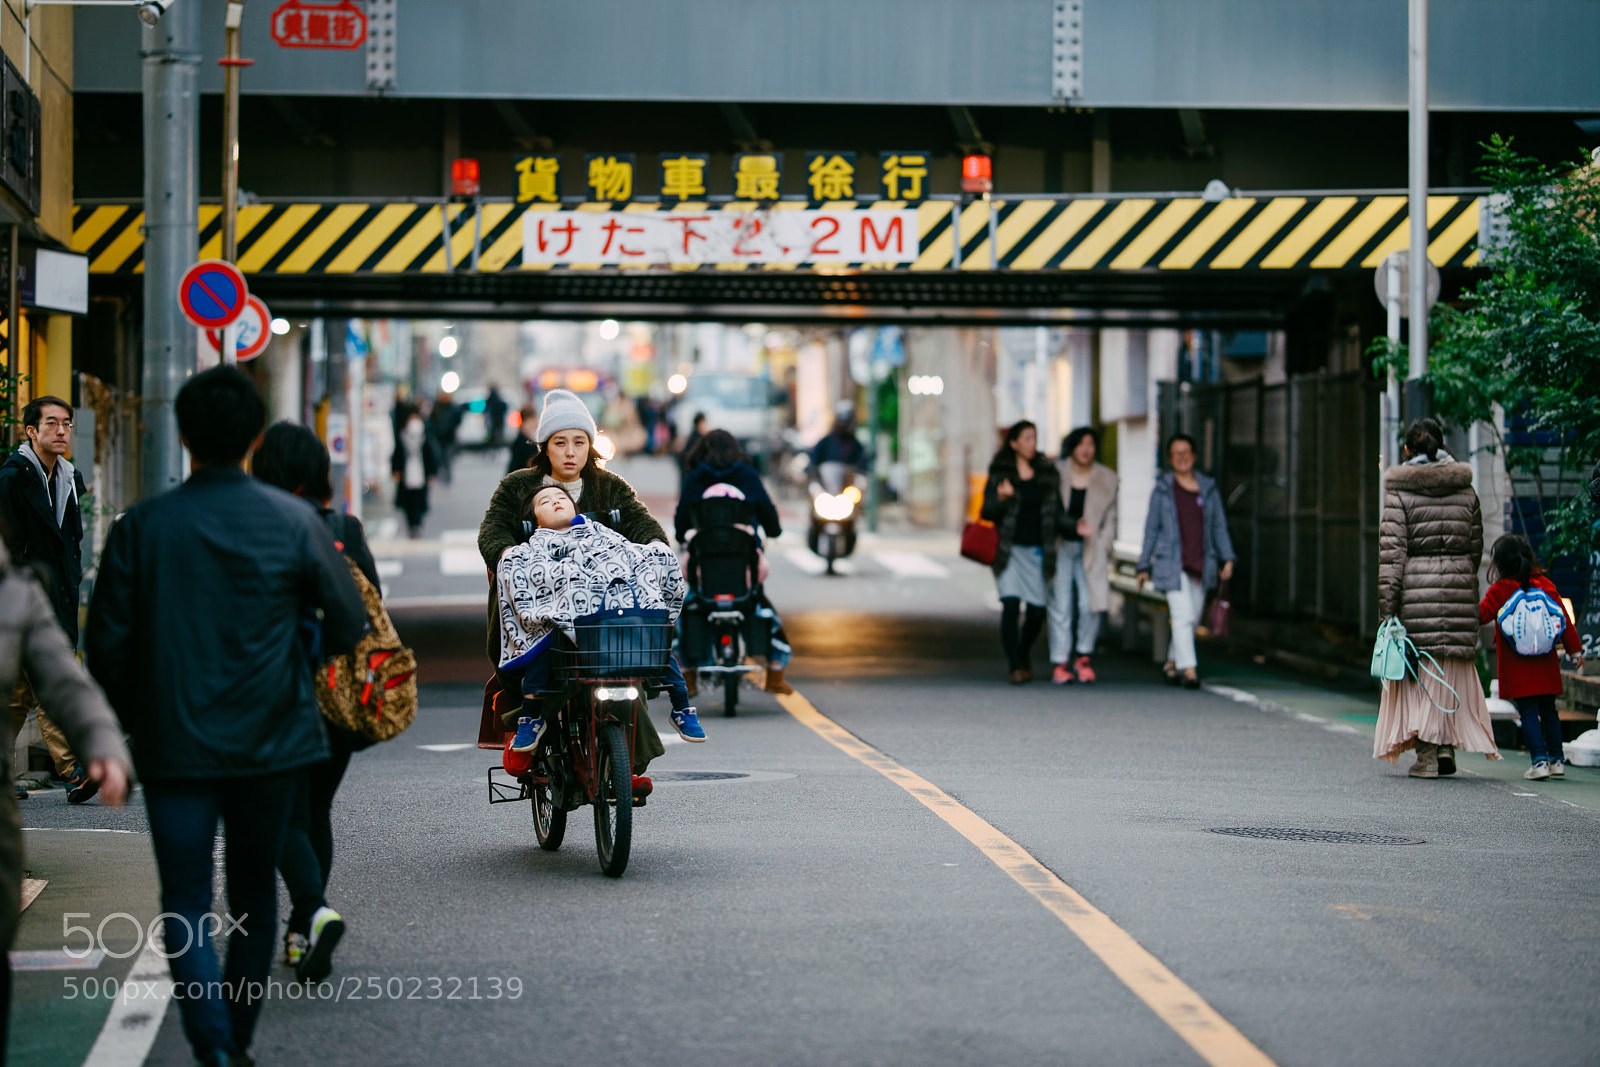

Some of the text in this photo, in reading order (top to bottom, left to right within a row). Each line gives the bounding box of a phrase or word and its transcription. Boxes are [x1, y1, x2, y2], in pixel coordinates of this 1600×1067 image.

[515, 156, 928, 202] 貨物車最徐行
